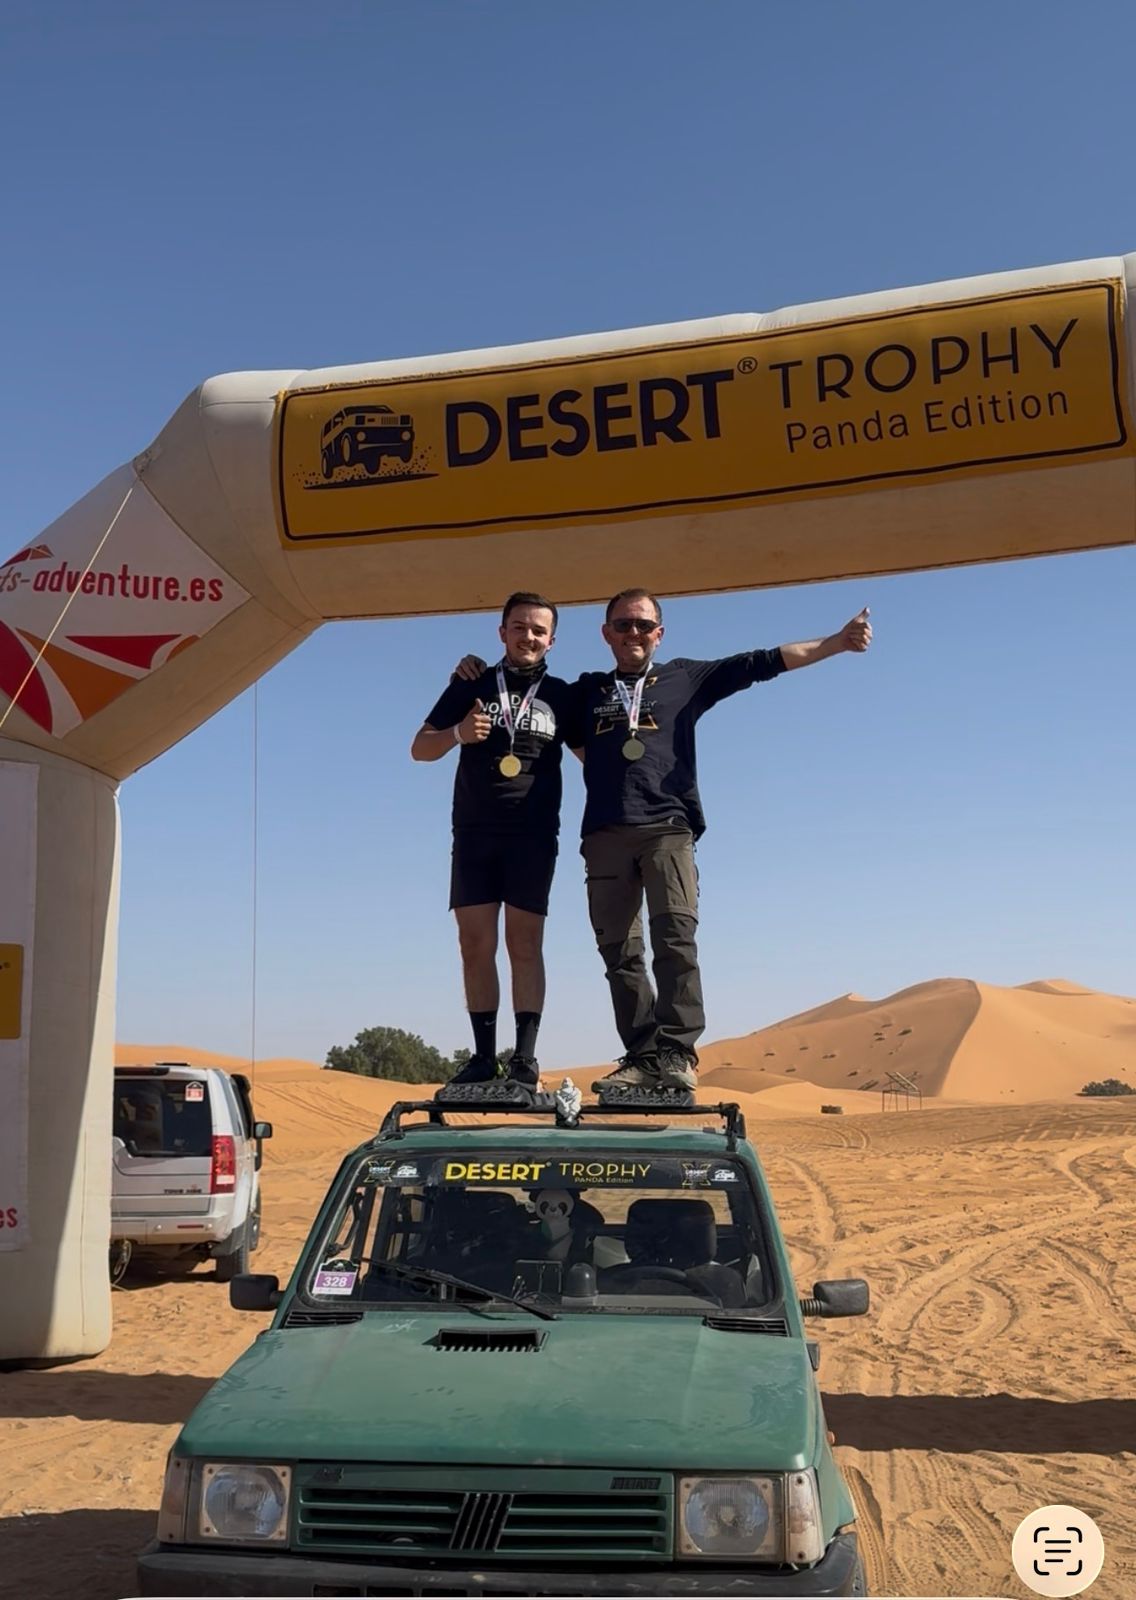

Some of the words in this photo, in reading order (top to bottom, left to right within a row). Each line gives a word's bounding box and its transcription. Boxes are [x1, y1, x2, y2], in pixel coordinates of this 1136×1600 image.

[769, 318, 1079, 408] TROPHY
[786, 410, 909, 453] Panda
[924, 390, 1068, 433] Edition
[559, 1163, 651, 1177] TROPHY
[322, 1276, 348, 1287] 328
